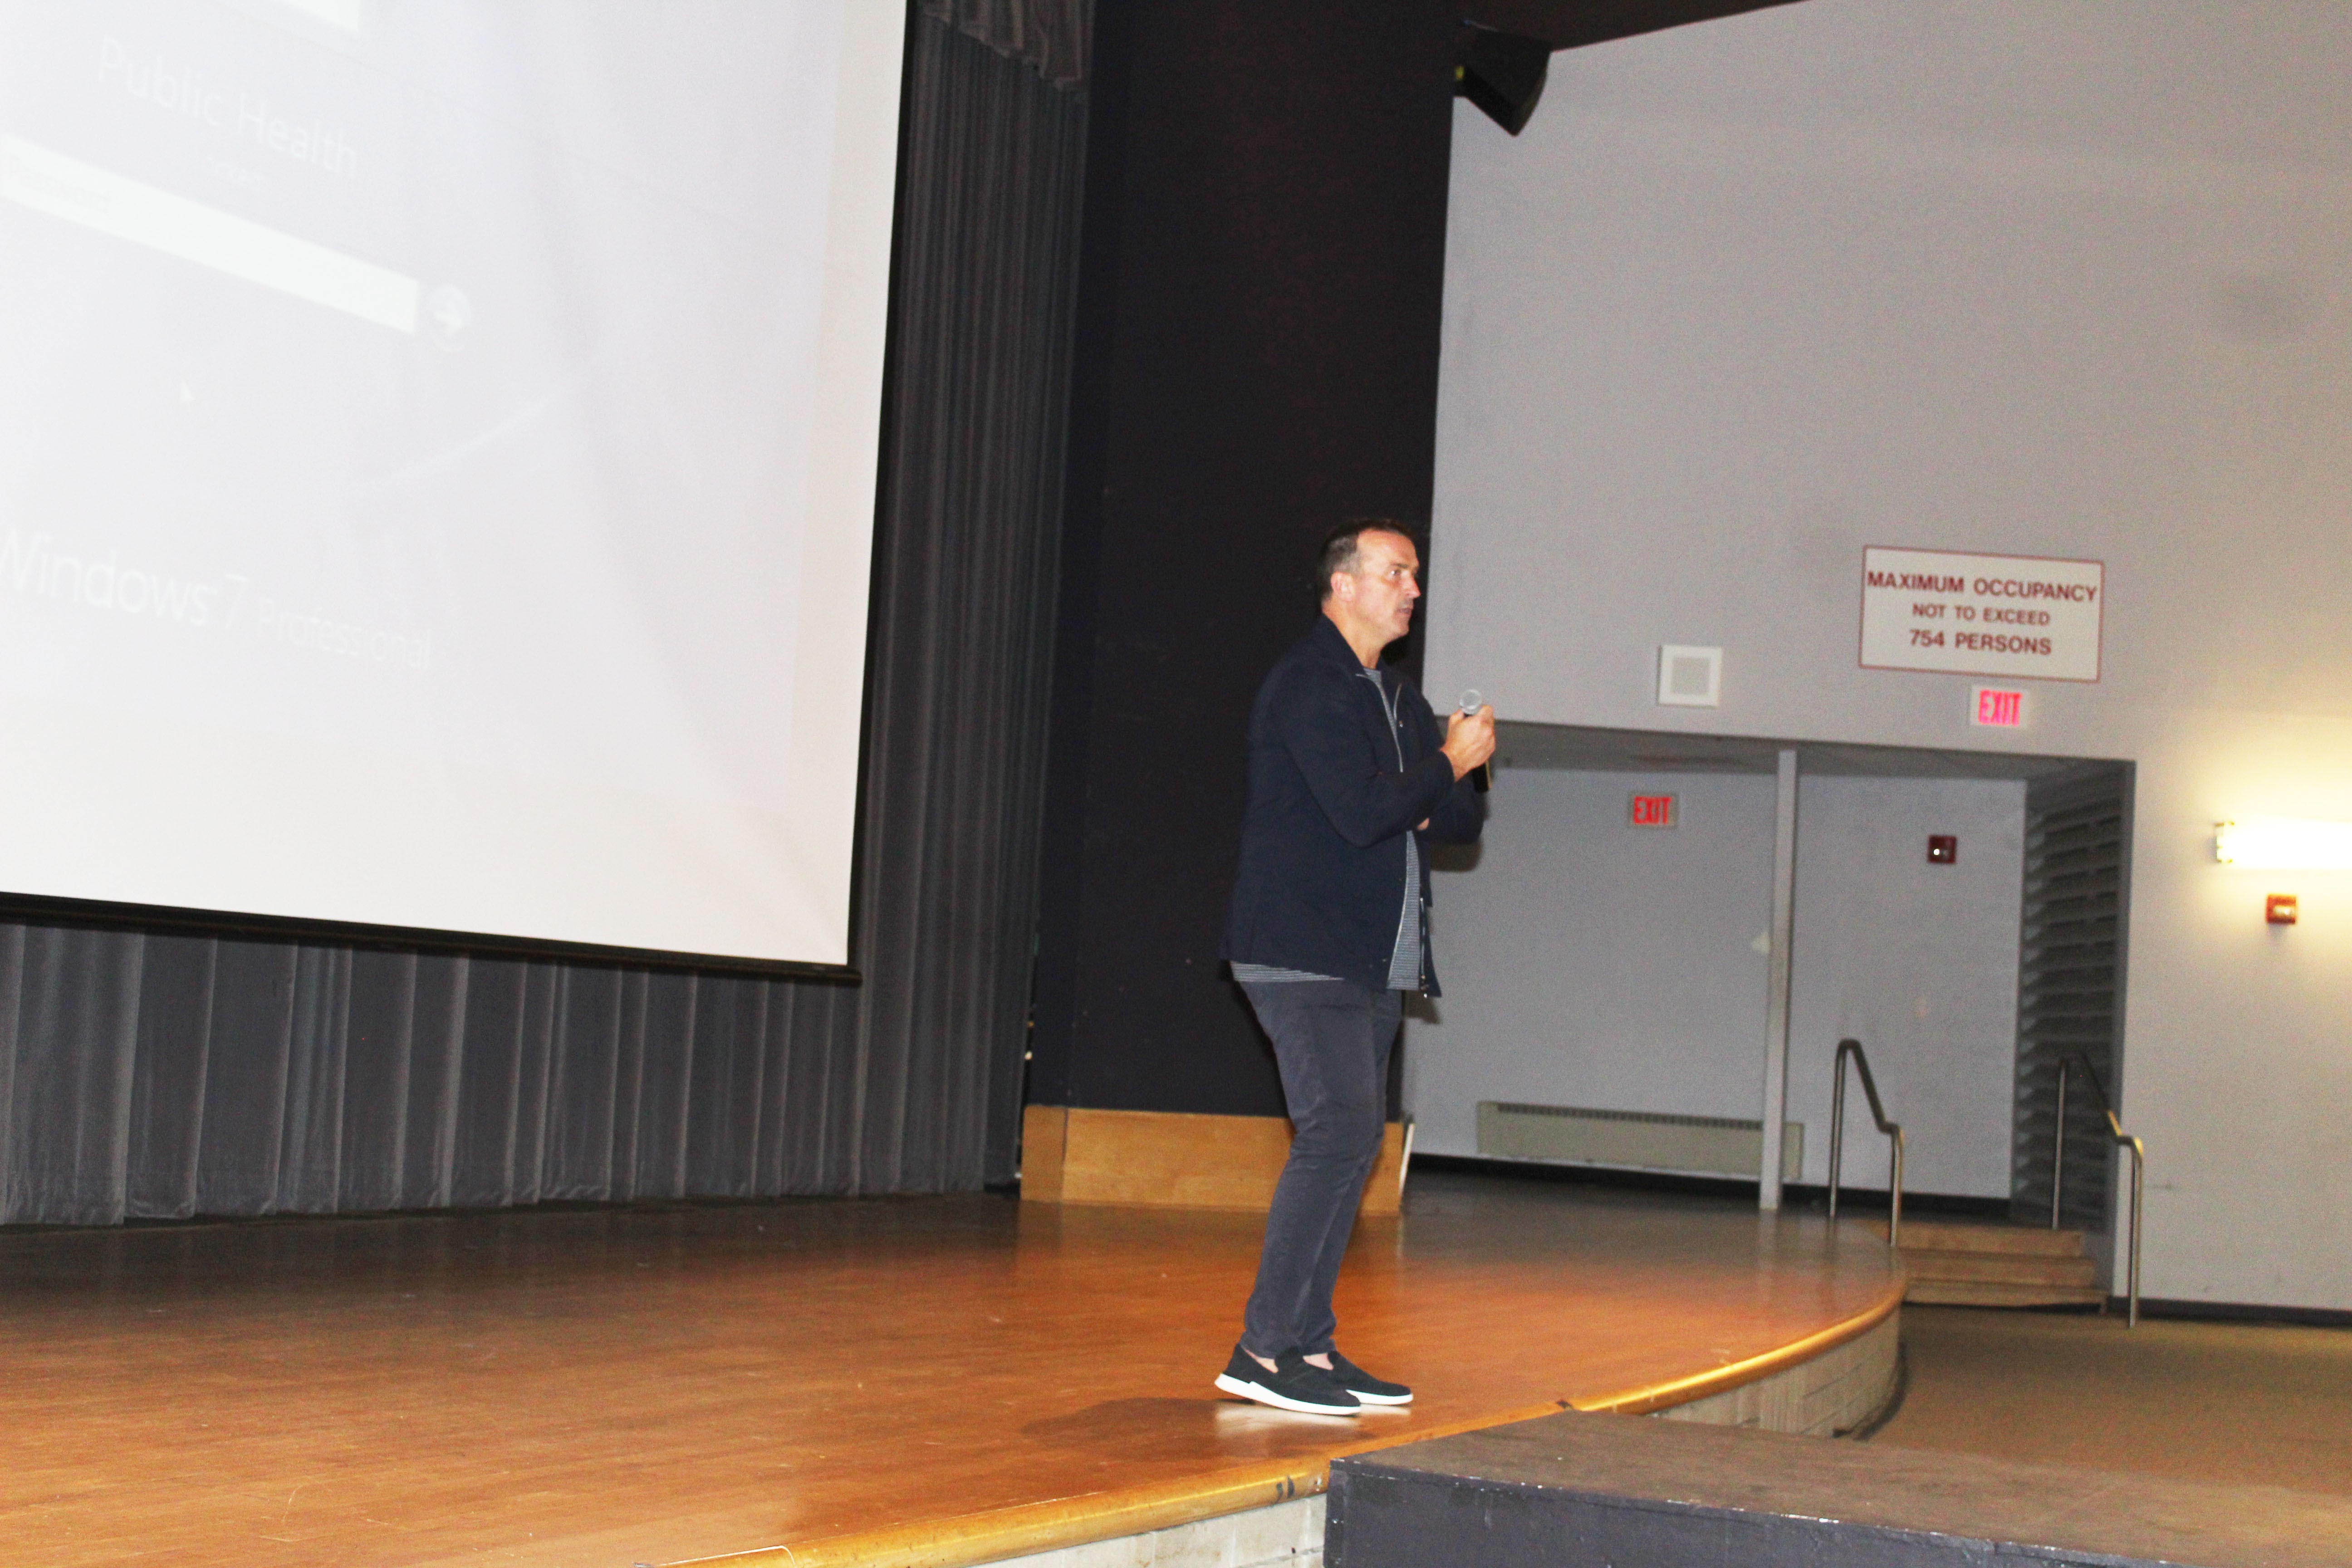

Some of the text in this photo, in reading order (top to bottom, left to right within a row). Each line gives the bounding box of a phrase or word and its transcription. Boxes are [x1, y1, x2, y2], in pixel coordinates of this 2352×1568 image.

[98, 35, 358, 179] Public Health
[1867, 571, 2097, 602] MAXIMUM OCCUPANCY
[223, 573, 248, 631] 7
[258, 596, 432, 670] Professional
[1912, 603, 2050, 626] NOT TO EXCEED
[1910, 629, 2052, 655] 754 PERSONS
[1978, 689, 2023, 726] EXIT
[1633, 796, 1672, 825] EXIT
